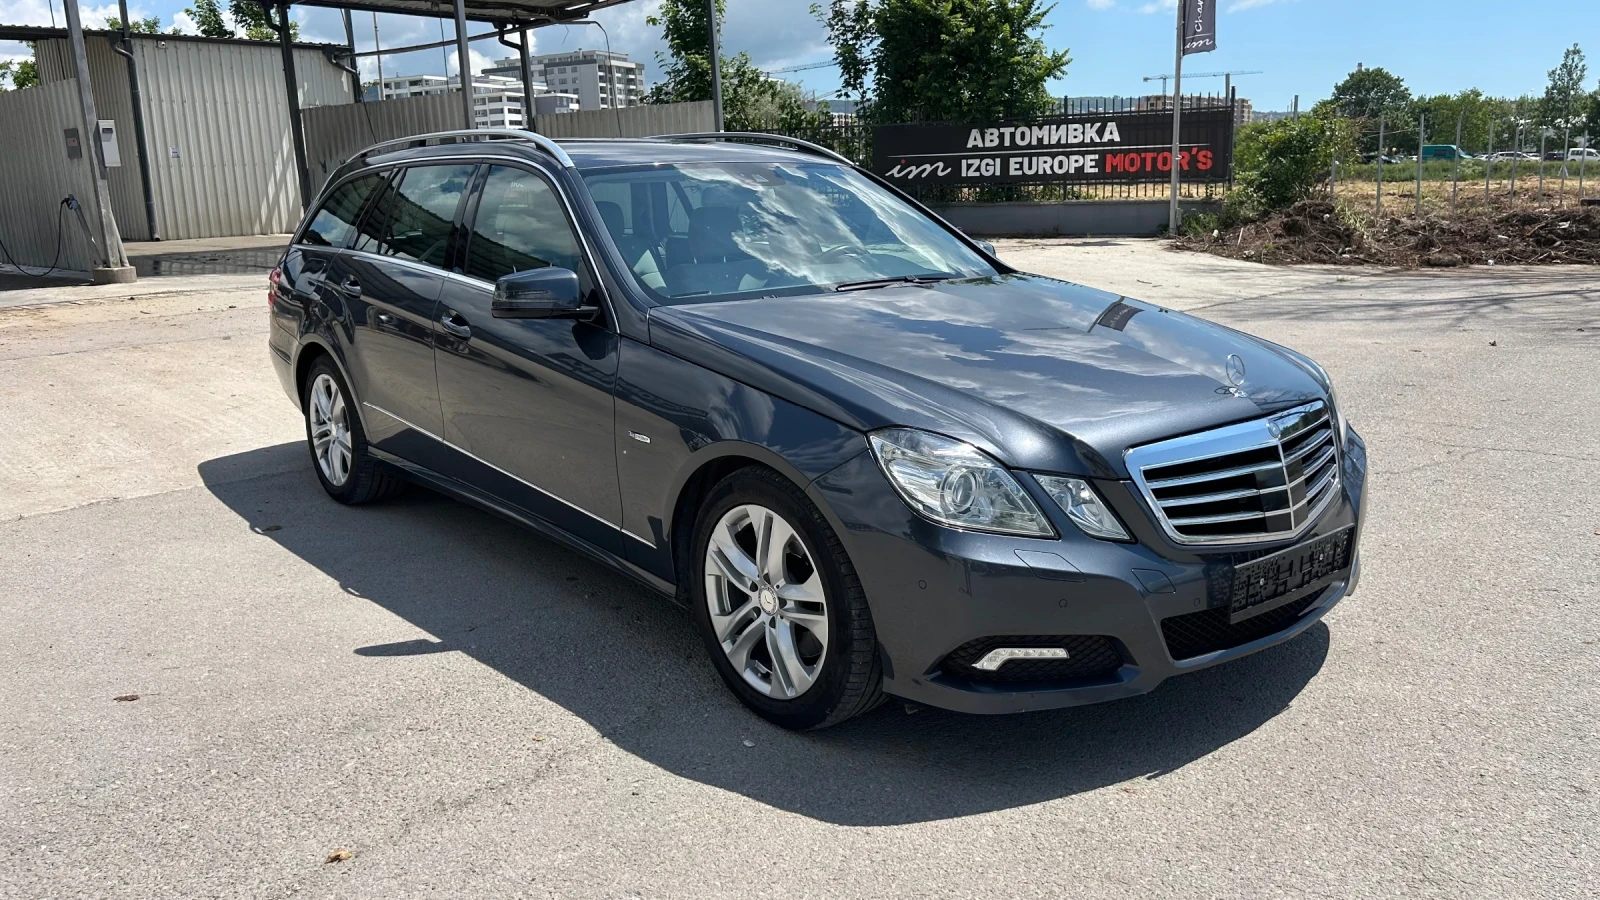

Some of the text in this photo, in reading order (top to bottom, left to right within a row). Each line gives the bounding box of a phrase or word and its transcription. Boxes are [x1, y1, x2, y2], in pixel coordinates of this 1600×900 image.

[966, 121, 1121, 149] АВТОМИВКА
[961, 147, 1213, 177] IZGI EUROPE MOTOR'S
